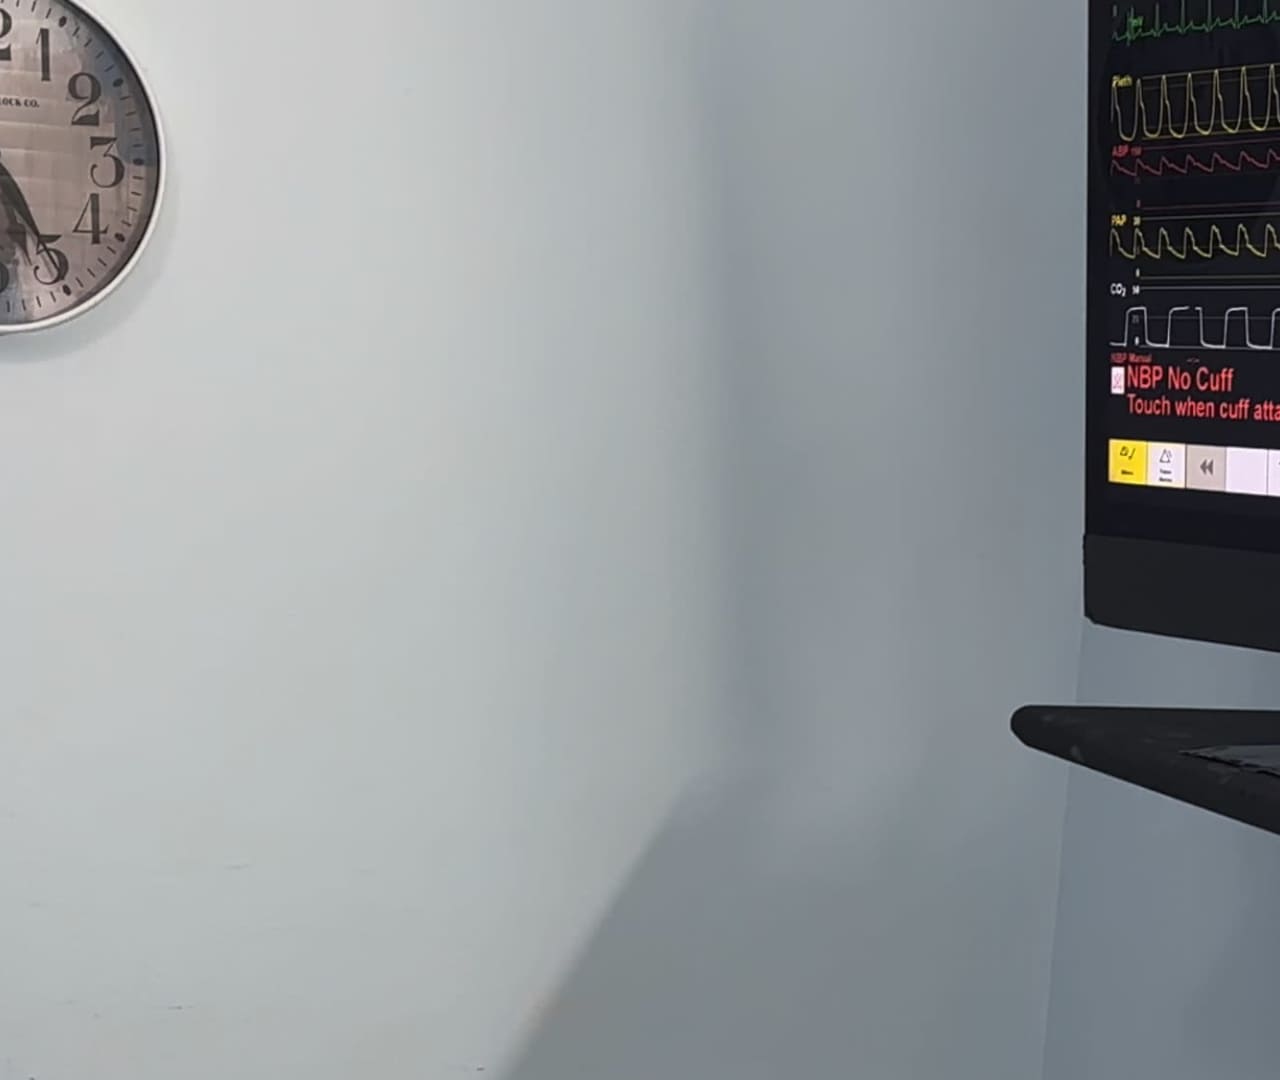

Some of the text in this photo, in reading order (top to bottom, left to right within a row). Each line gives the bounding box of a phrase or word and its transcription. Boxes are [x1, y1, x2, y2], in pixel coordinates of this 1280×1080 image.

[35, 28, 52, 82] 1
[67, 72, 102, 127] 2
[89, 136, 126, 188] 3
[72, 193, 110, 245] 4
[33, 233, 70, 286] 5
[1126, 364, 1234, 392] NBP No Cuff
[1126, 393, 1170, 416] Touch
[1174, 395, 1215, 418] when
[1219, 398, 1250, 420] cuff
